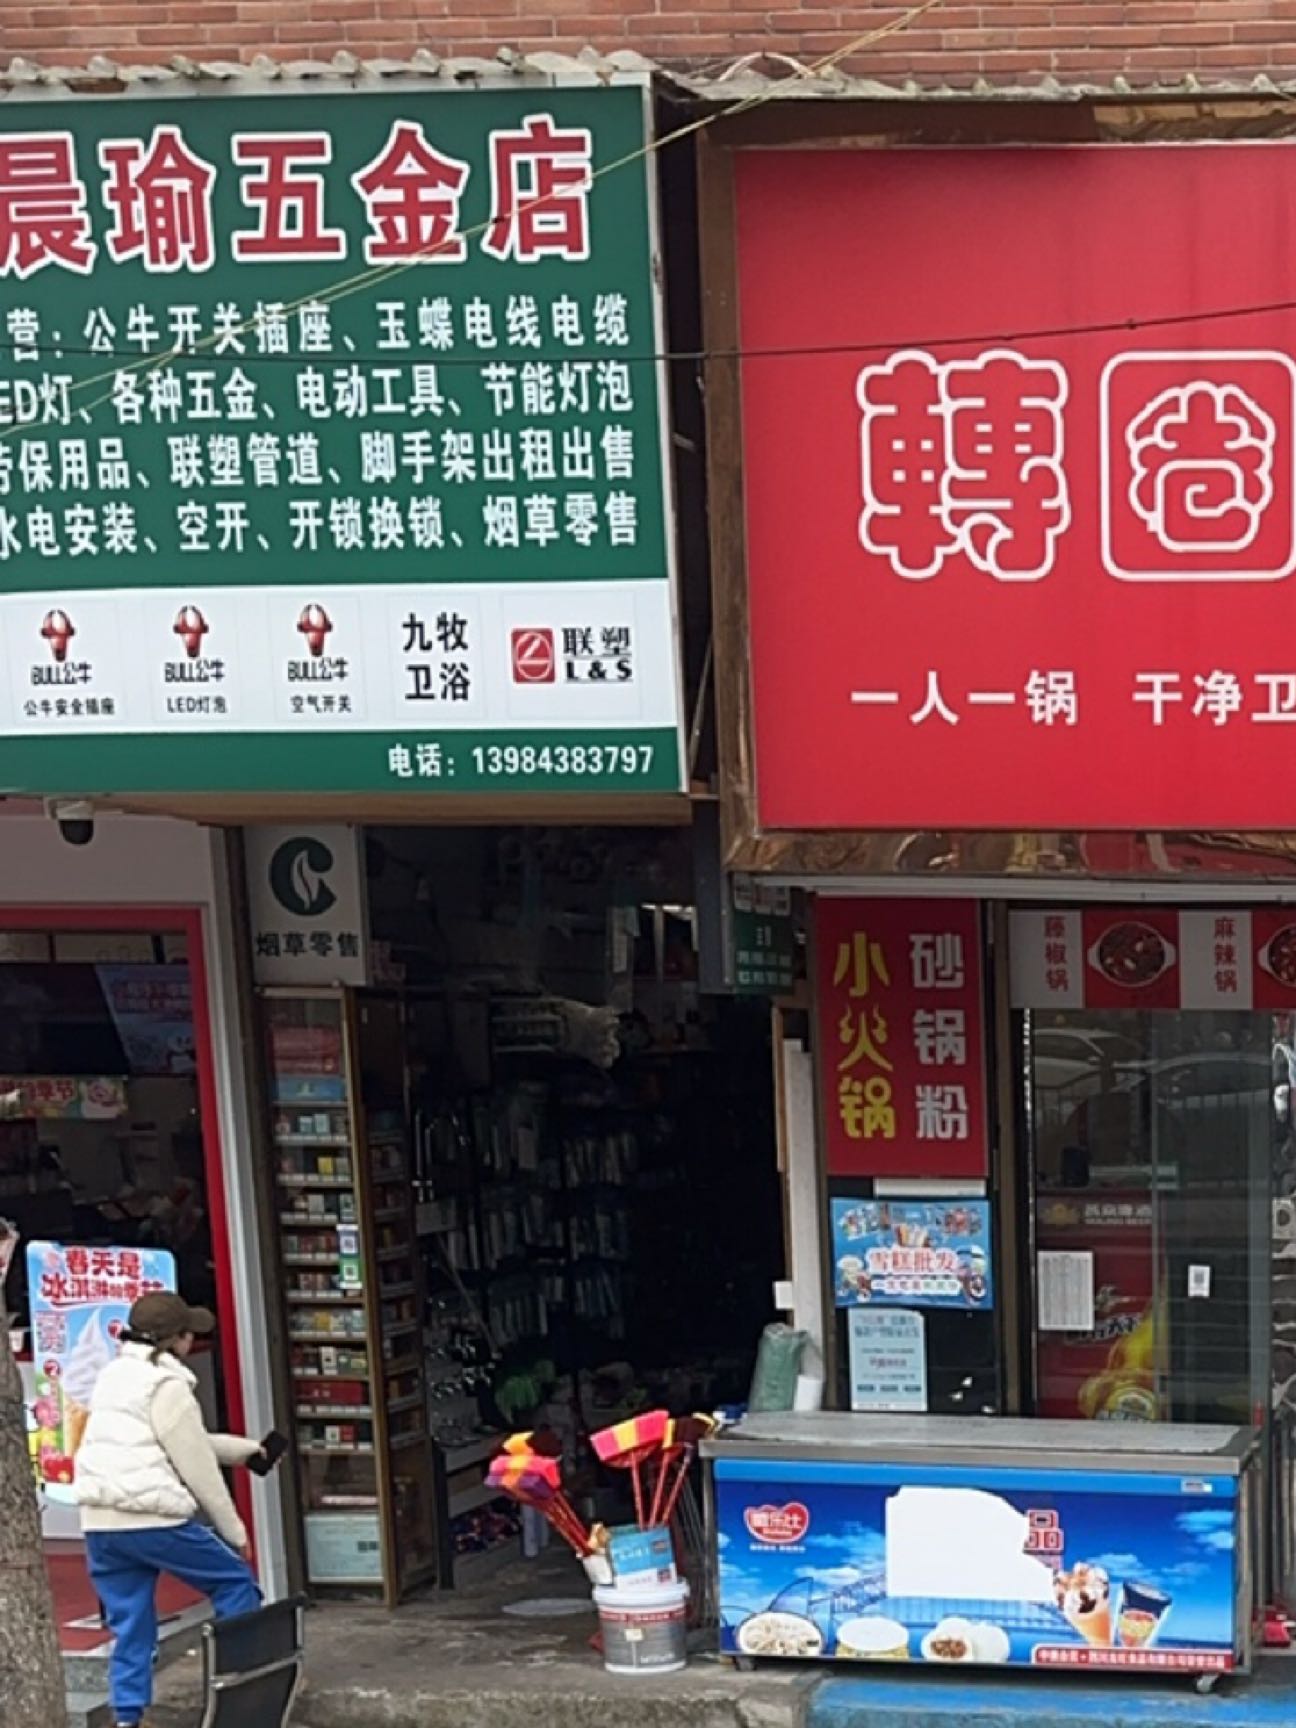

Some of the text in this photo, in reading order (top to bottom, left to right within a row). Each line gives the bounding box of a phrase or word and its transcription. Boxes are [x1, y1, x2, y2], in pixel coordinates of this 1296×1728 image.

[0, 114, 591, 278] 晨瑜五金店
[402, 611, 469, 653] 九牧
[562, 626, 632, 657] 联塑
[405, 662, 471, 702] 卫浴
[851, 669, 1079, 727] 一人一锅
[23, 697, 116, 717] 公牛安全插座
[166, 695, 228, 714] LED灯泡
[290, 694, 352, 714] 空气开关
[256, 931, 360, 960] 烟草零售
[1213, 915, 1238, 994] 麻辣锅
[832, 931, 897, 1139] 小火锅
[908, 933, 969, 1139] 砂锅粉
[65, 1246, 140, 1280] 春天是
[868, 1247, 959, 1273] 雪糕批发
